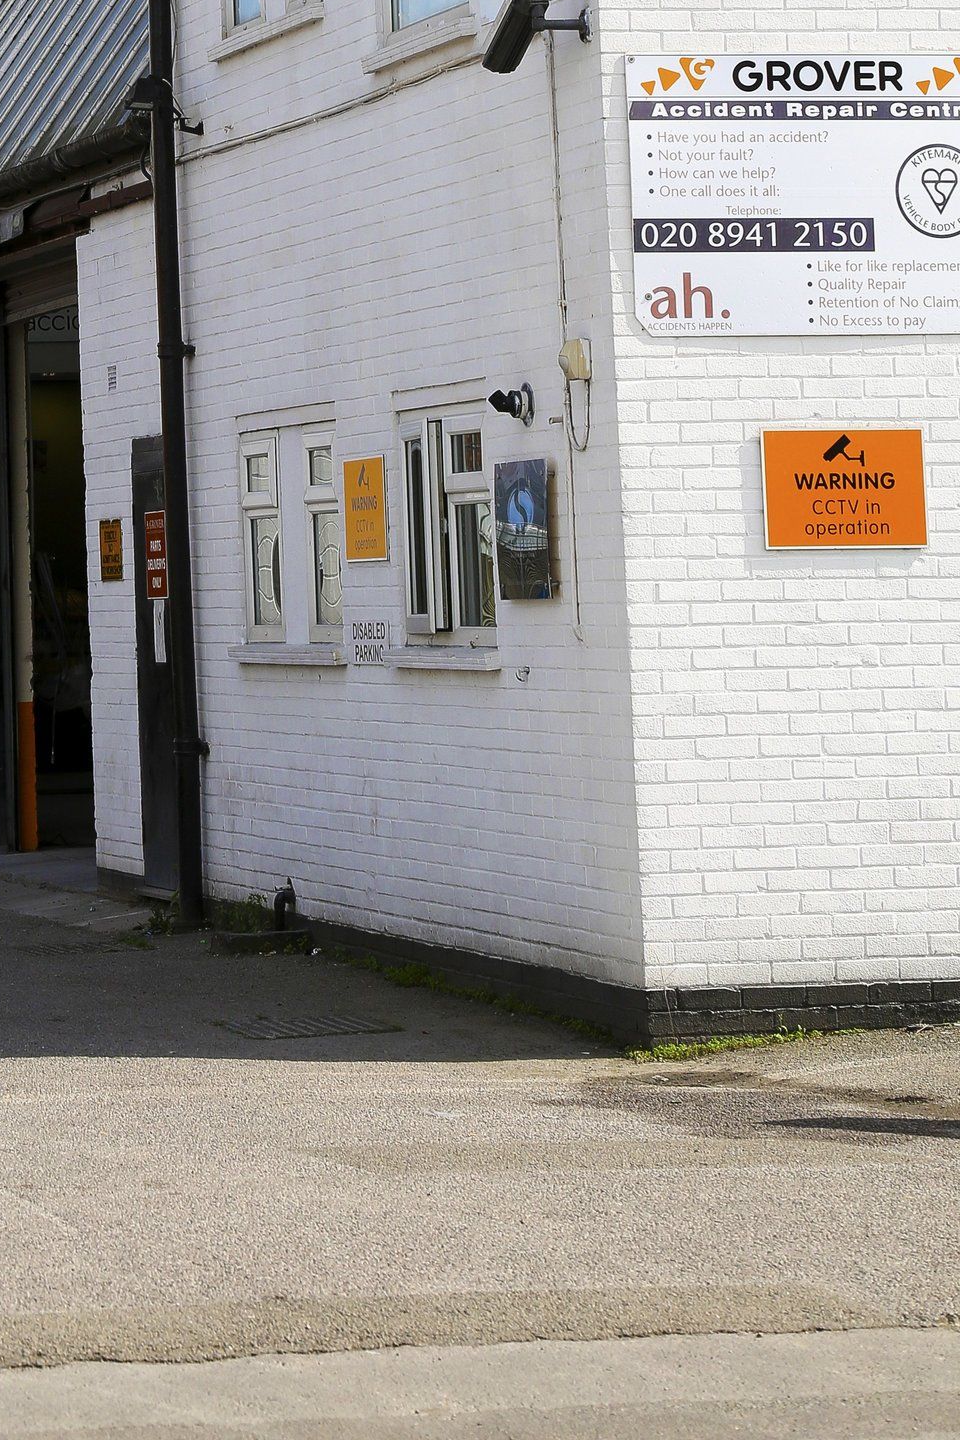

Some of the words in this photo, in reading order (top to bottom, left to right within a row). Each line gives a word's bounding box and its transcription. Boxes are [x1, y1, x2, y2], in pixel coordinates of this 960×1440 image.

[732, 60, 903, 92] GROVER
[651, 102, 774, 117] Accident
[786, 101, 878, 120] Repair
[657, 131, 689, 143] Have
[693, 134, 717, 146] you
[721, 131, 745, 143] had
[749, 134, 765, 143] an
[769, 130, 829, 143] accident?
[658, 149, 683, 161] Not
[686, 151, 715, 164] your
[719, 148, 754, 161] fault?
[659, 167, 689, 179] How
[692, 169, 715, 179] can
[719, 169, 738, 179] we
[742, 166, 776, 182] help?
[659, 185, 687, 197] One
[690, 185, 712, 197] call
[716, 185, 746, 197] does
[749, 185, 759, 197] it
[762, 185, 781, 197] all:
[725, 205, 782, 218] Telephone:
[903, 194, 929, 229] VEHICLE
[930, 221, 956, 232] BODY
[641, 222, 697, 248] 020
[708, 221, 777, 248] 8941
[793, 221, 868, 247] 2150
[817, 260, 841, 272] Like
[845, 260, 863, 272] for
[867, 260, 888, 272] like
[817, 278, 863, 293] Quality
[867, 278, 907, 293] Repair
[650, 272, 731, 320] ah.
[818, 296, 879, 308] Retention
[883, 296, 896, 308] of
[899, 296, 919, 308] No
[647, 322, 697, 331] ACCIDENTS
[698, 322, 733, 331] HAPPEN
[819, 314, 839, 327] No
[843, 314, 883, 327] Excess
[887, 316, 901, 327] to
[904, 317, 927, 329] pay
[794, 472, 896, 490] WARNING
[351, 495, 378, 511] WARNING
[812, 499, 859, 515] CCTV
[865, 499, 881, 515] in
[355, 520, 369, 533] CCTV
[804, 519, 891, 539] operation
[354, 537, 378, 553] operation
[352, 622, 386, 640] DISABLED
